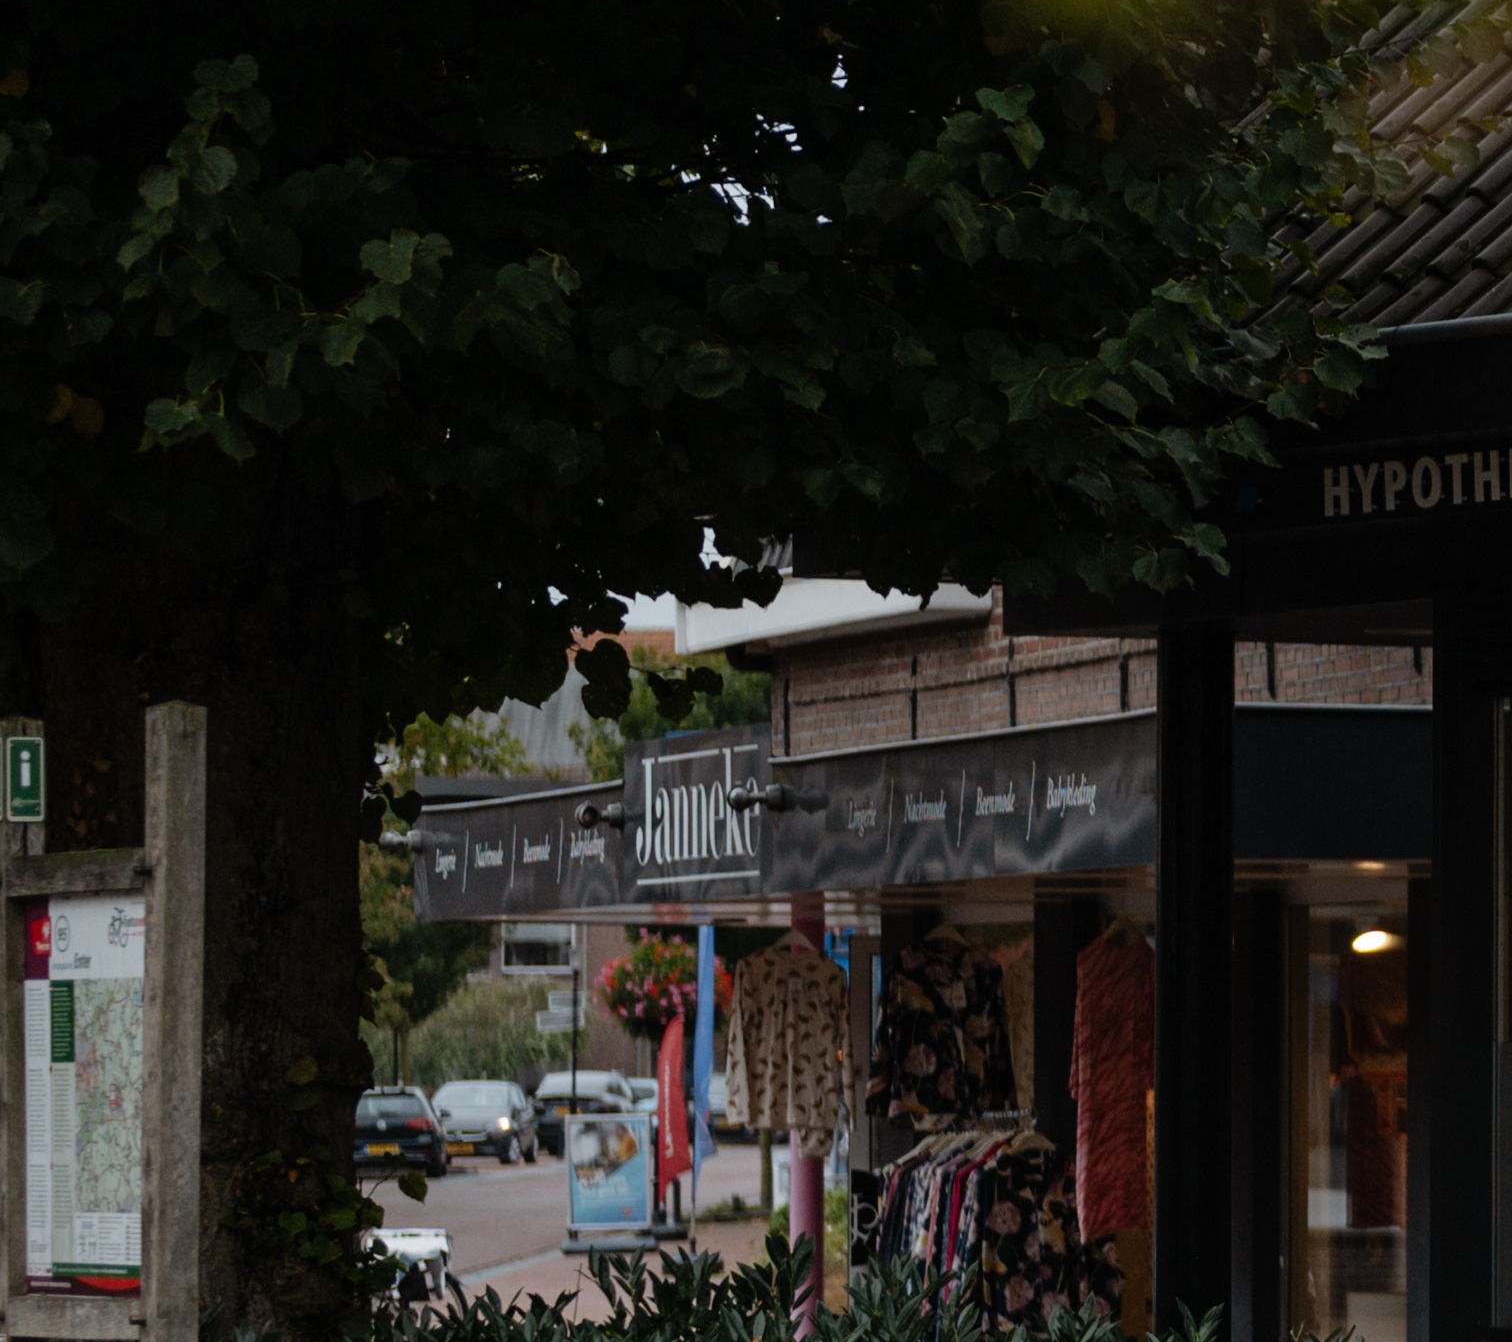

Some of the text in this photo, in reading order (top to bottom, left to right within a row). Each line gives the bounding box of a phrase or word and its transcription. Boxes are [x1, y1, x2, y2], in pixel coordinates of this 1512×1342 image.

[636, 748, 761, 867] Janneke
[976, 781, 1015, 816] Beenmode
[1046, 772, 1097, 817] Babykleding
